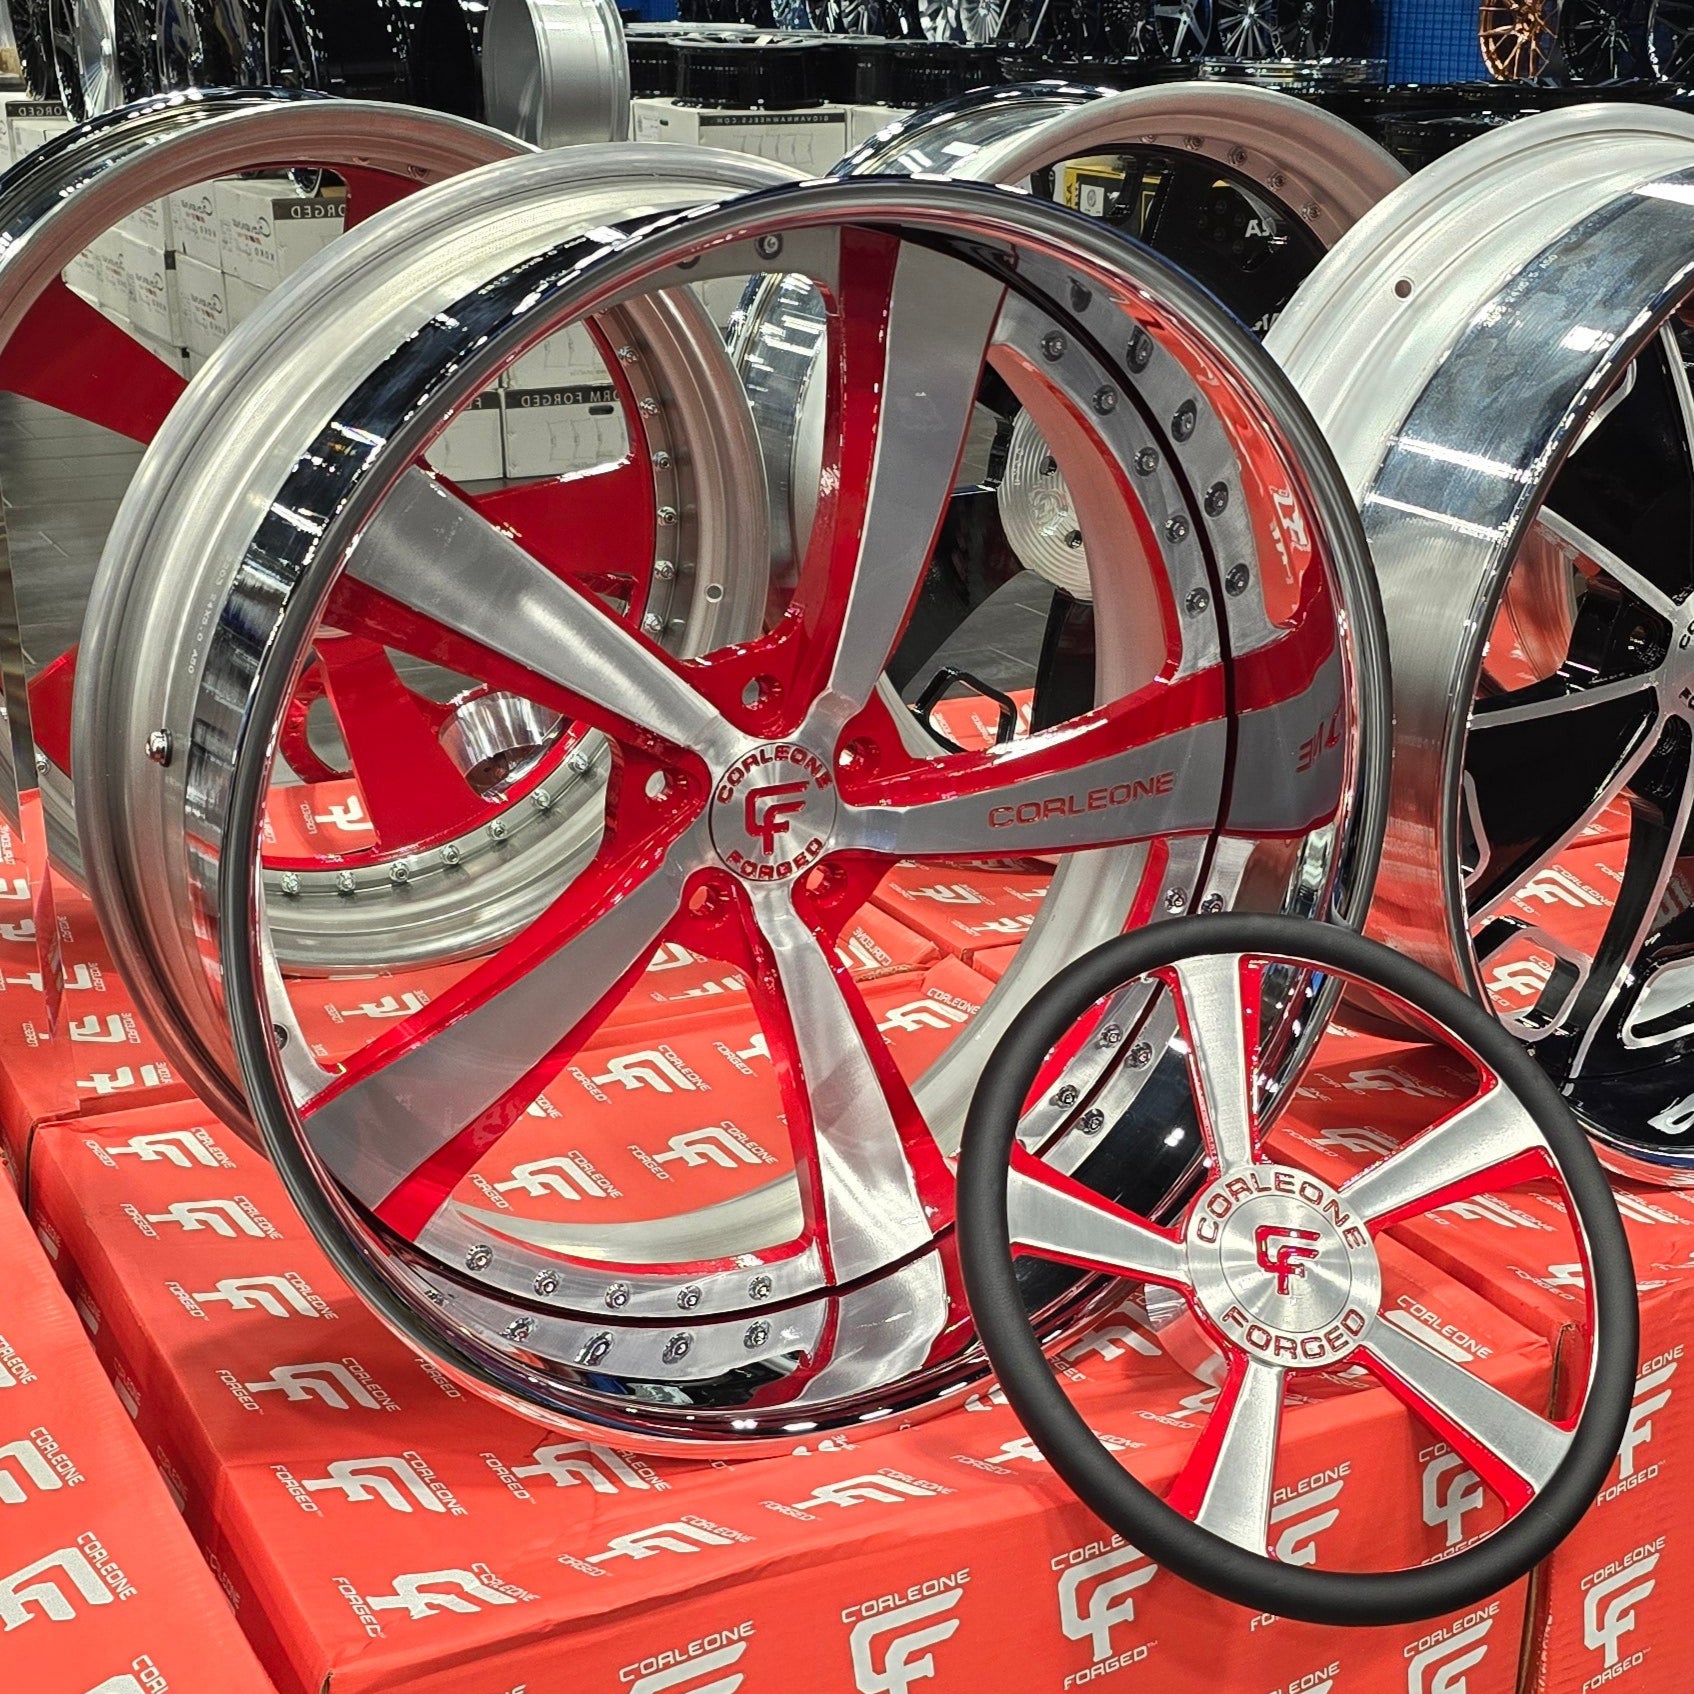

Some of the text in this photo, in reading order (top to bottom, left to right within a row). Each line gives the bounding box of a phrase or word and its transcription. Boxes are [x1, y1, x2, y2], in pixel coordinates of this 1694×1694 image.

[717, 745, 833, 804] CORLEONE
[988, 771, 1176, 829] CORLEONE
[726, 838, 823, 880] FORGED
[1552, 865, 1616, 907] CORLEONE
[927, 987, 981, 1015] CORLEONE
[657, 1044, 713, 1092] CORLEONE
[190, 1127, 237, 1169] CORLEONE
[720, 1120, 779, 1165] CORLEONE
[567, 1149, 624, 1199] CORLEONE
[234, 1195, 284, 1240] CORLEONE
[1197, 1172, 1367, 1249] CORLEONE
[284, 1271, 339, 1321] CORLEONE
[1222, 1306, 1365, 1359] FORGED
[1397, 1294, 1494, 1359] CORLEONE
[341, 1357, 402, 1414] CORLEONE
[29, 1426, 86, 1488] CORLEONE
[402, 1450, 469, 1517] CORLEONE
[1273, 1460, 1351, 1504] RLEONE
[680, 1514, 757, 1544] CORLEONE
[1051, 1533, 1128, 1571] CORLE
[76, 1530, 138, 1602] CORLEONE
[1581, 1536, 1667, 1591] CORLEONE
[841, 1568, 972, 1624] CORLEONE
[618, 1620, 758, 1683] CORLEONE
[1403, 1600, 1501, 1658] CORLEONE
